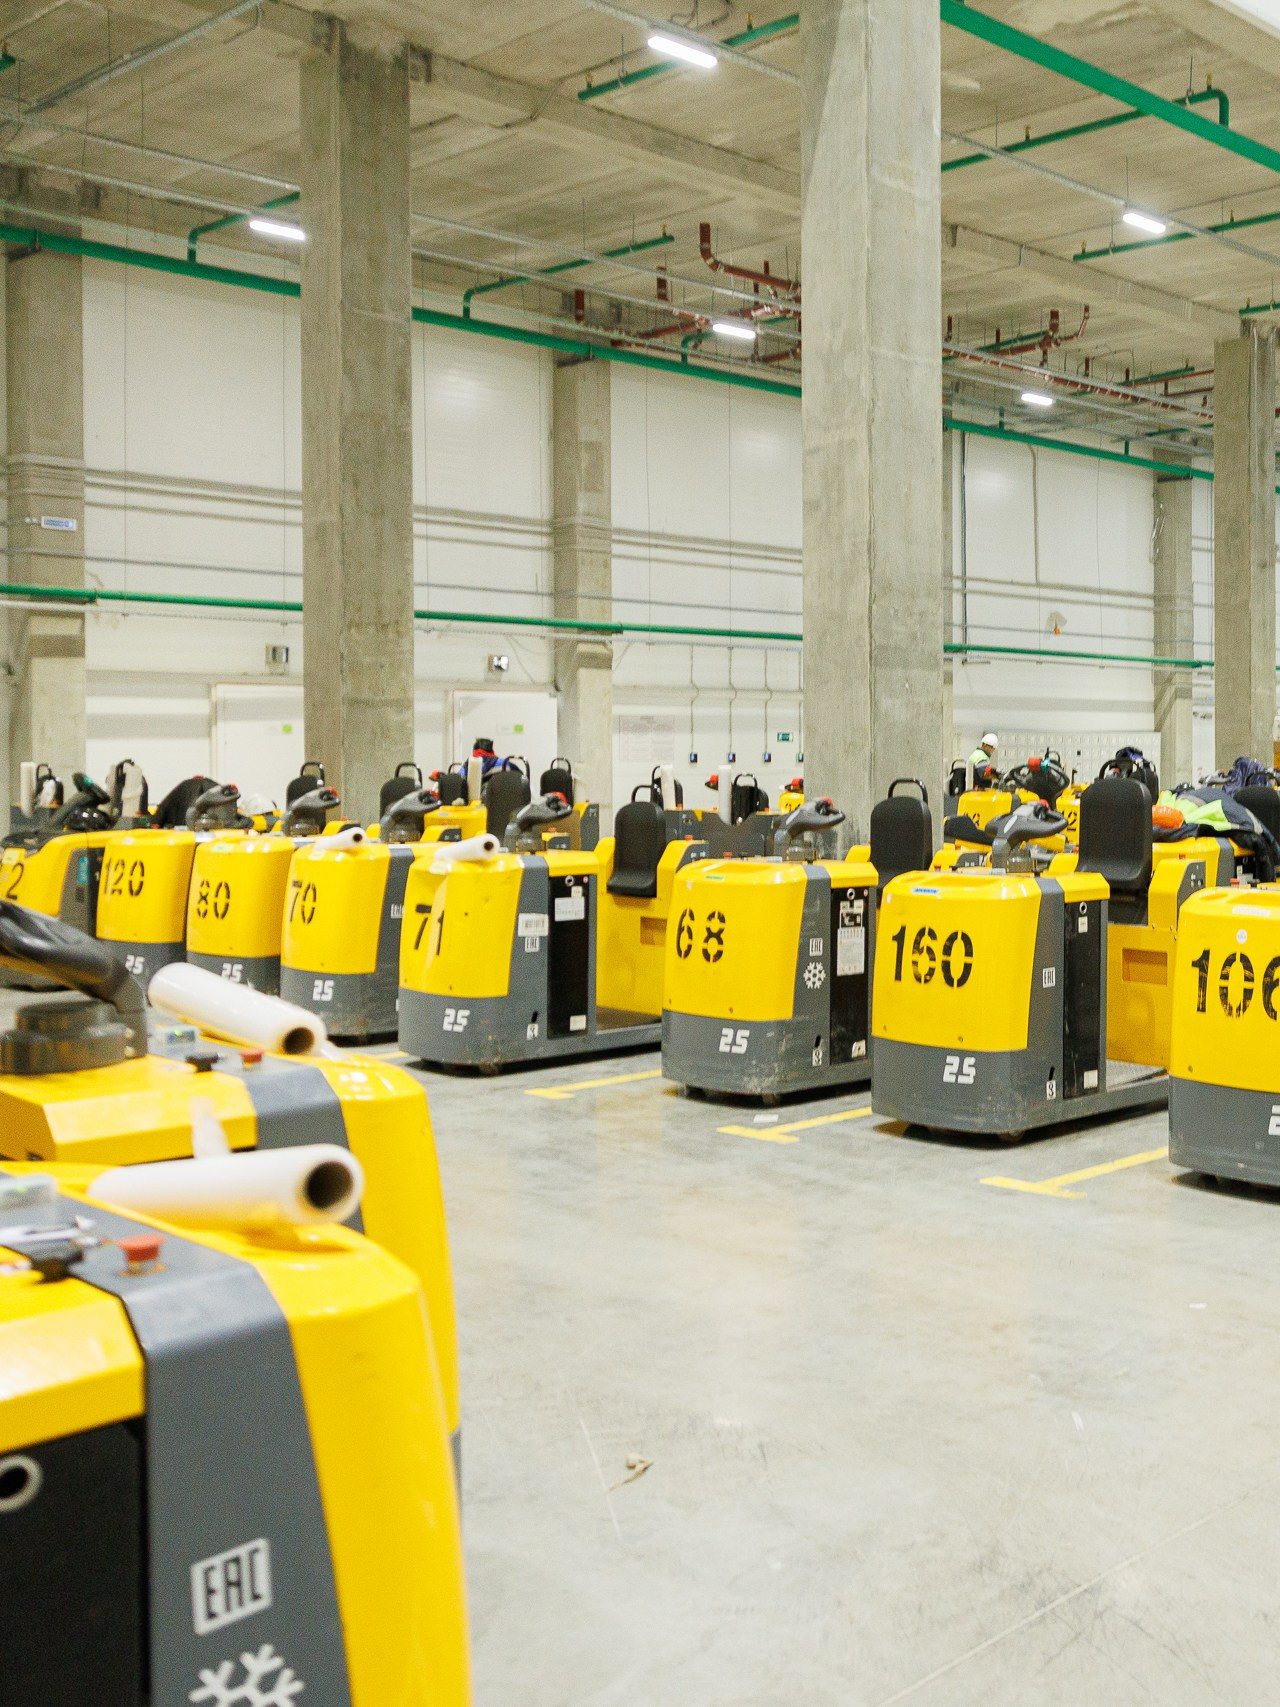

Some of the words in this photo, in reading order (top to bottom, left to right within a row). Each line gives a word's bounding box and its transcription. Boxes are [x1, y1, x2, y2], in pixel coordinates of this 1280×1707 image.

[1062, 811, 1077, 831] 2
[104, 858, 144, 897] 120
[197, 880, 230, 919] 80
[290, 880, 317, 924] 70
[414, 904, 445, 956] 71
[676, 908, 727, 963] 68
[125, 954, 146, 975] 25
[892, 925, 974, 989] 160
[312, 979, 335, 1001] 25
[443, 1008, 470, 1033] 25
[719, 1027, 751, 1054] 25
[943, 1055, 977, 1085] 25
[203, 1546, 264, 1620] EAC
